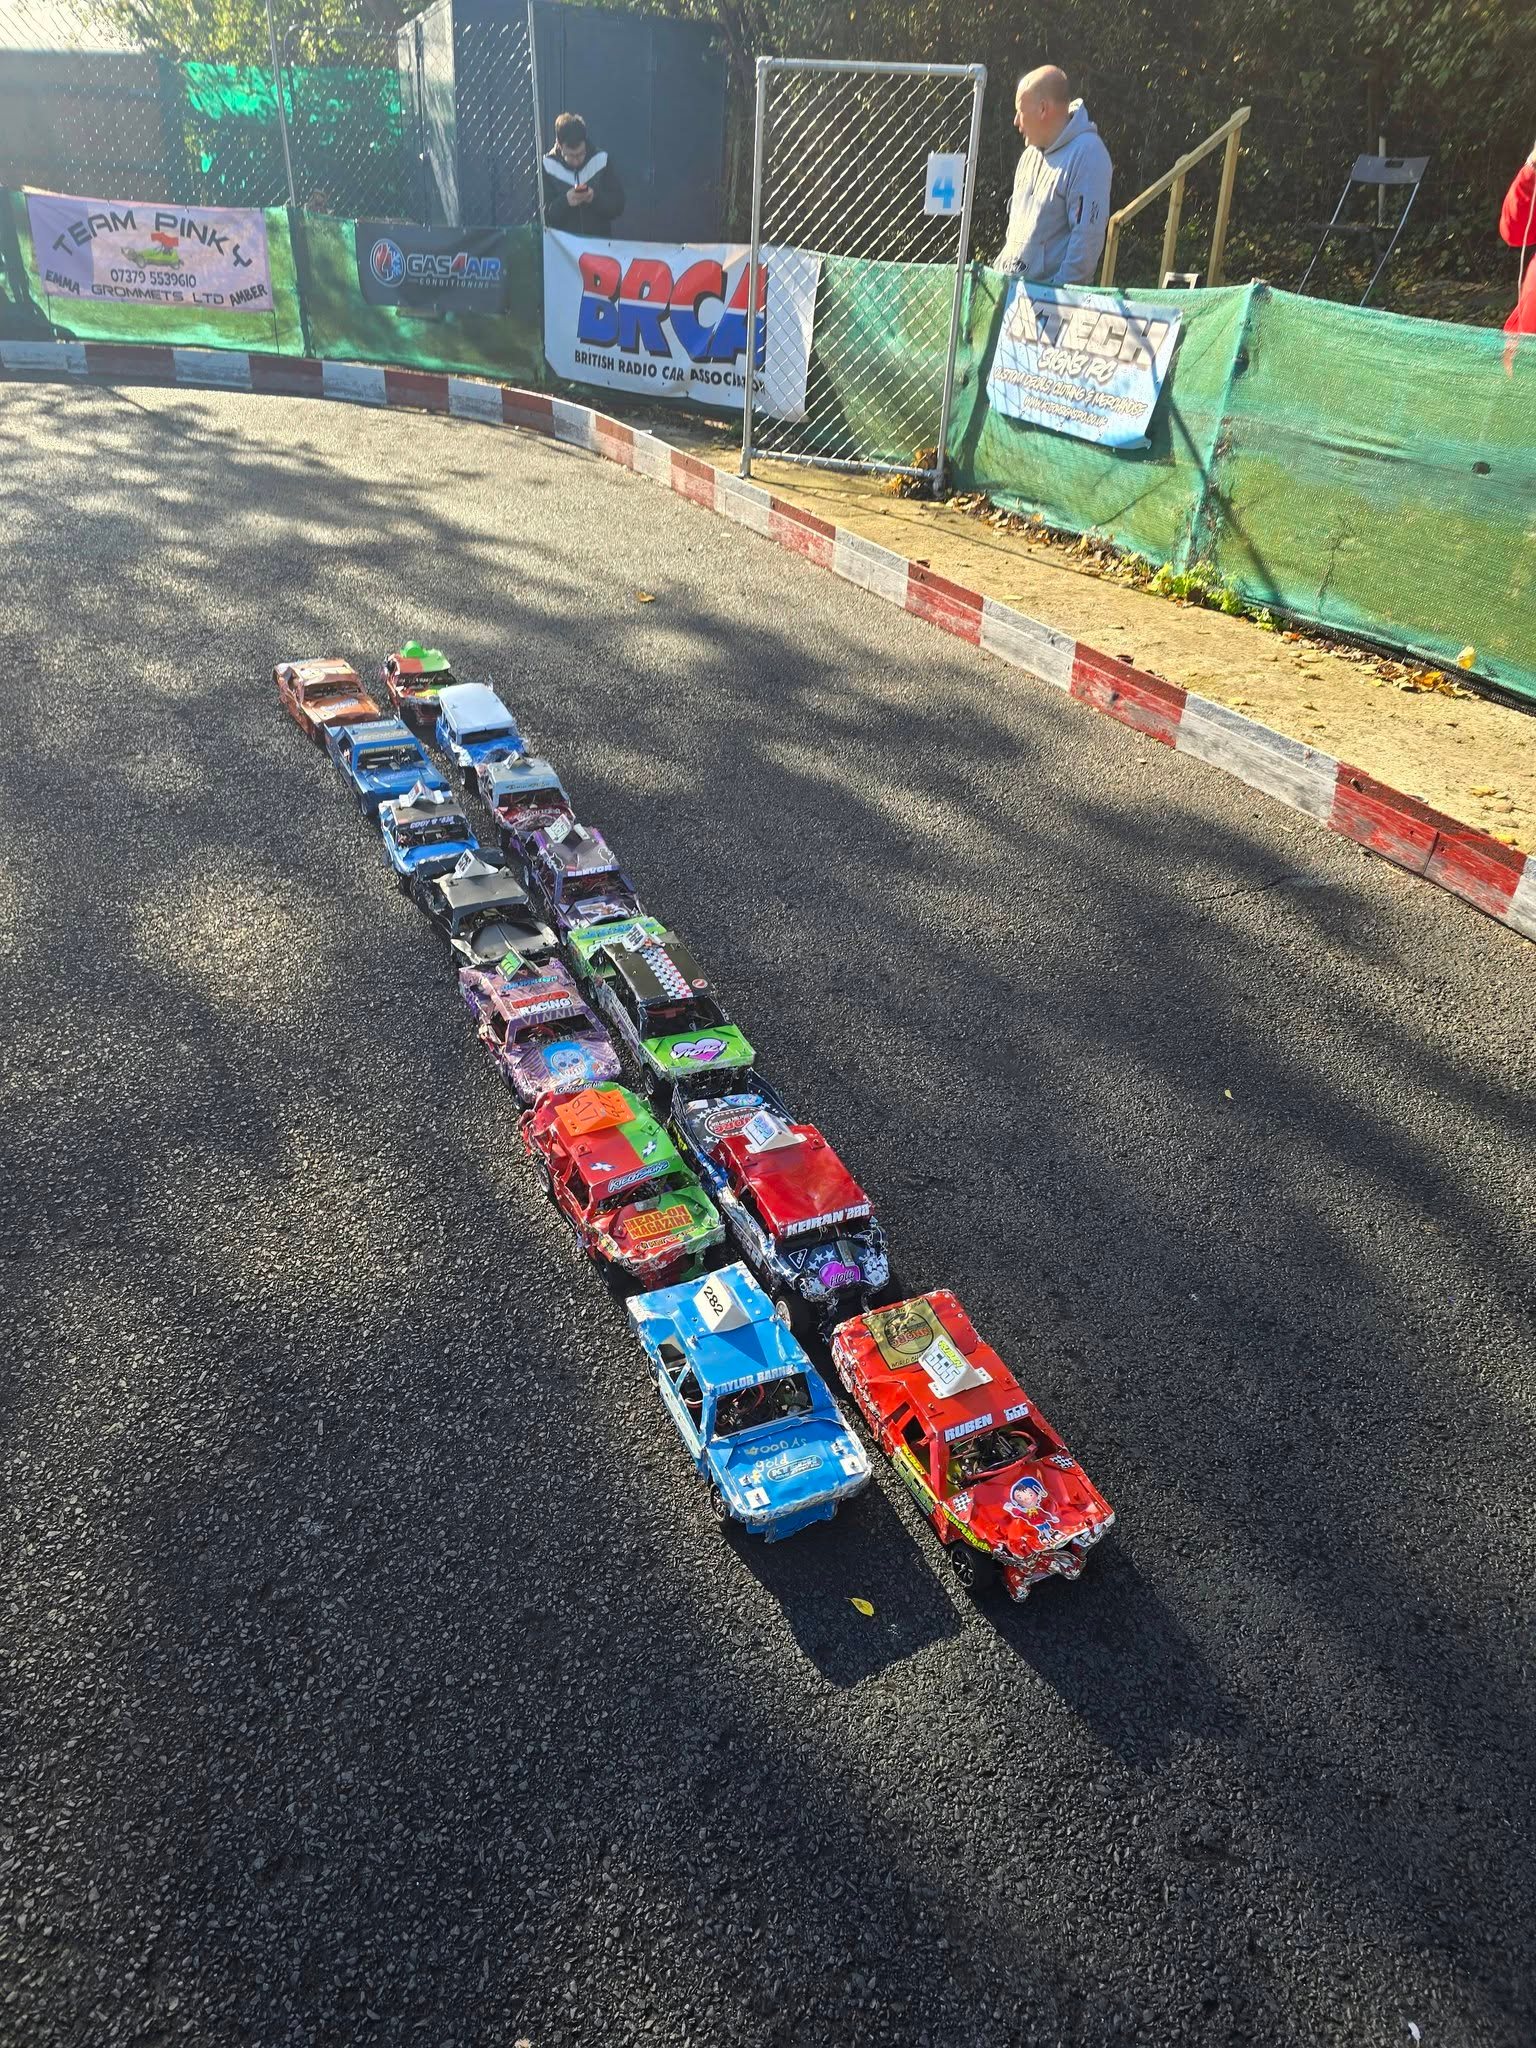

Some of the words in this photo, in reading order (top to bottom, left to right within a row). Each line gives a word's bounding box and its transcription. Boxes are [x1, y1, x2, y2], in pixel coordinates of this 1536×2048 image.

[931, 174, 956, 209] 4
[52, 210, 137, 257] TEAM
[110, 268, 146, 284] 07379
[406, 252, 501, 281] GAS4AIR
[45, 268, 80, 295] EMMA
[91, 283, 184, 303] GROMMETS
[192, 291, 225, 305] LTD
[229, 283, 268, 307] AMBER
[419, 278, 490, 289] CONDITIONING
[577, 252, 769, 374] BRCA
[574, 348, 615, 371] BRITISH
[618, 360, 658, 378] RADIO
[661, 365, 685, 382] CAR
[519, 997, 573, 1016] RACING
[521, 1006, 582, 1025] VINNIE
[623, 1204, 688, 1231] HEAD-ON
[629, 1214, 694, 1239] MAGAZINE
[786, 1210, 844, 1237] KEIRAN
[702, 1285, 724, 1316] 282
[937, 1340, 964, 1368] RUBEN
[715, 1374, 754, 1393] TAYLOR
[944, 1413, 993, 1443] RUBEN
[755, 1452, 789, 1472] gold
